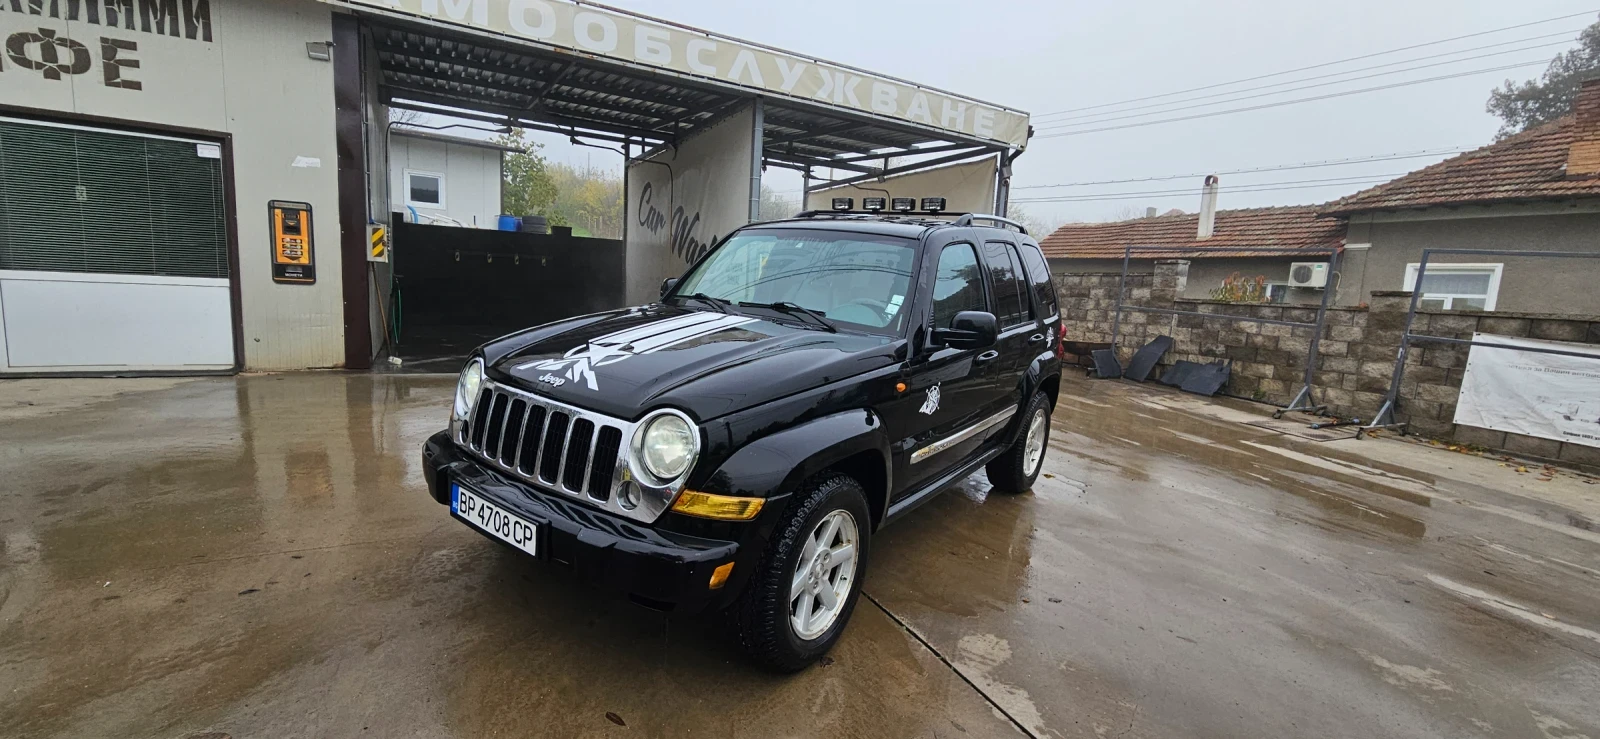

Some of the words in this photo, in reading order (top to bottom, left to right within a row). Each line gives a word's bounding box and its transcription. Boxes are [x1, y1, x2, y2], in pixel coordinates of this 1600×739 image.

[0, 27, 143, 91] ФЕ
[639, 181, 666, 236] Car
[671, 205, 718, 266] Wa
[538, 372, 566, 388] Jeep
[477, 503, 510, 538] 4708
